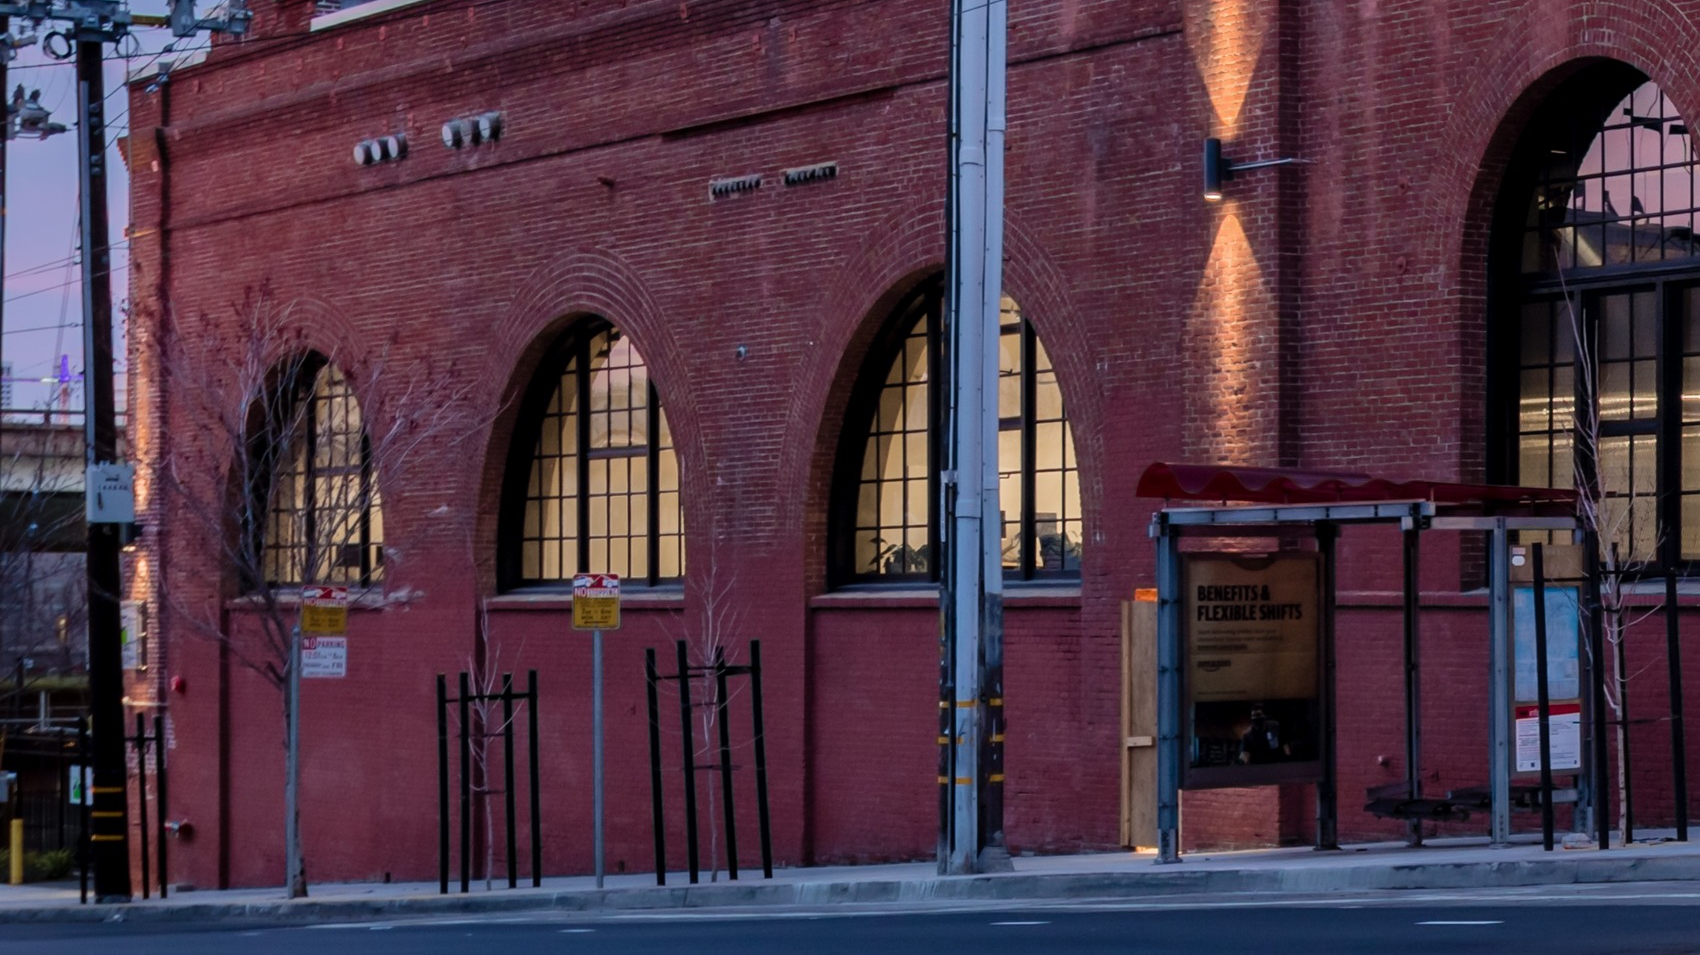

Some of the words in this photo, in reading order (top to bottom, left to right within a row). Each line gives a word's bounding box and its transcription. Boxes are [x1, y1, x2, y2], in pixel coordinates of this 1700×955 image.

[574, 587, 587, 597] NO
[1197, 585, 1258, 601] BENEFITS
[1260, 585, 1271, 601] &
[1197, 605, 1257, 621] FLEXIBLE
[1259, 604, 1302, 620] SHIFTS
[303, 638, 316, 648] NO
[317, 640, 344, 648] PARKING
